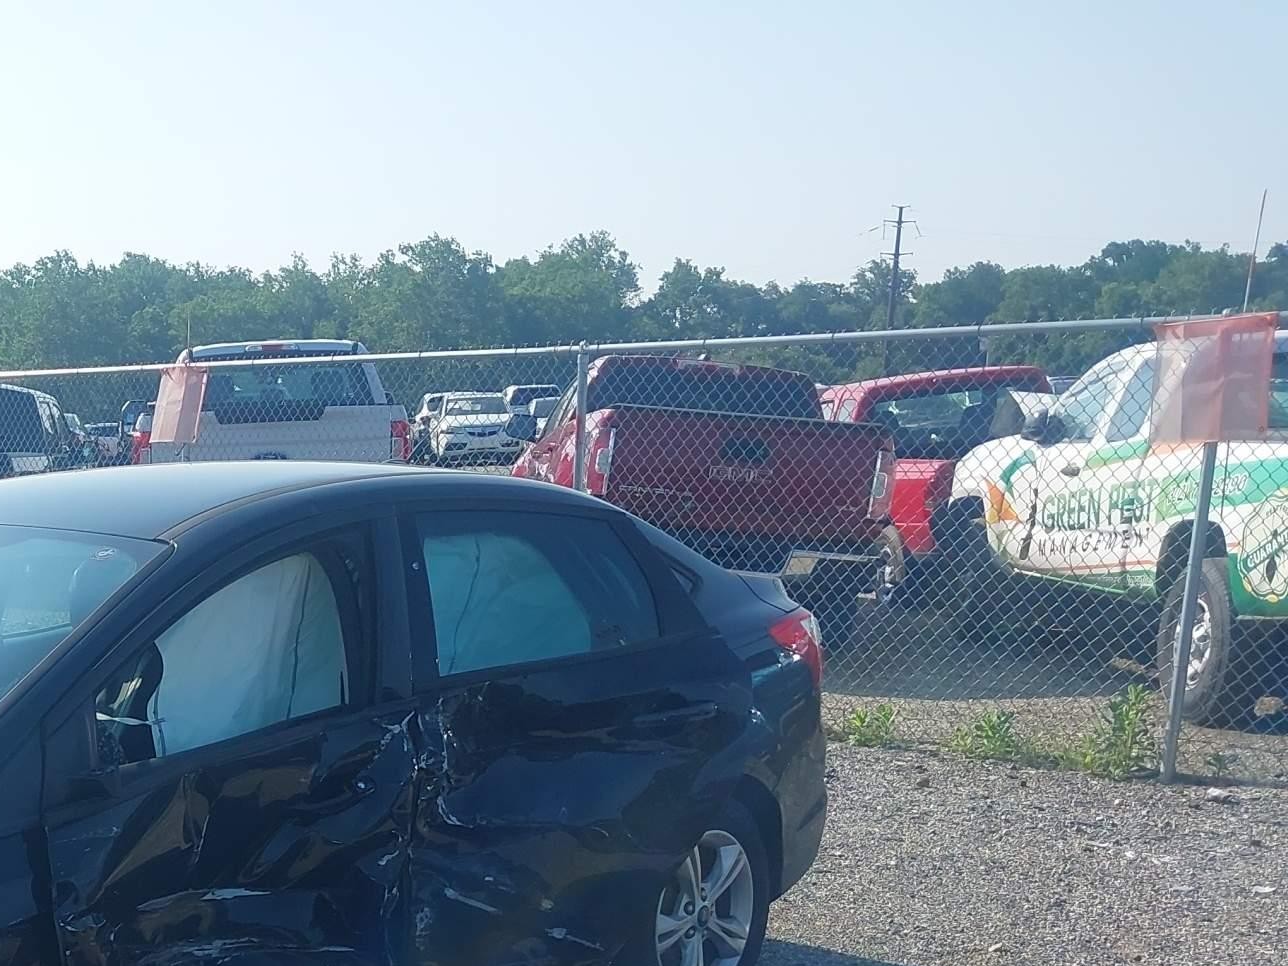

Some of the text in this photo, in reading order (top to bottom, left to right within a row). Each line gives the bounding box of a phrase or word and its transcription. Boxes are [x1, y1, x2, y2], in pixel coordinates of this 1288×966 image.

[709, 465, 773, 484] GMC
[1042, 487, 1102, 534] GREEN
[1108, 479, 1157, 526] PEST
[1038, 527, 1150, 557] MANAGEMENT
